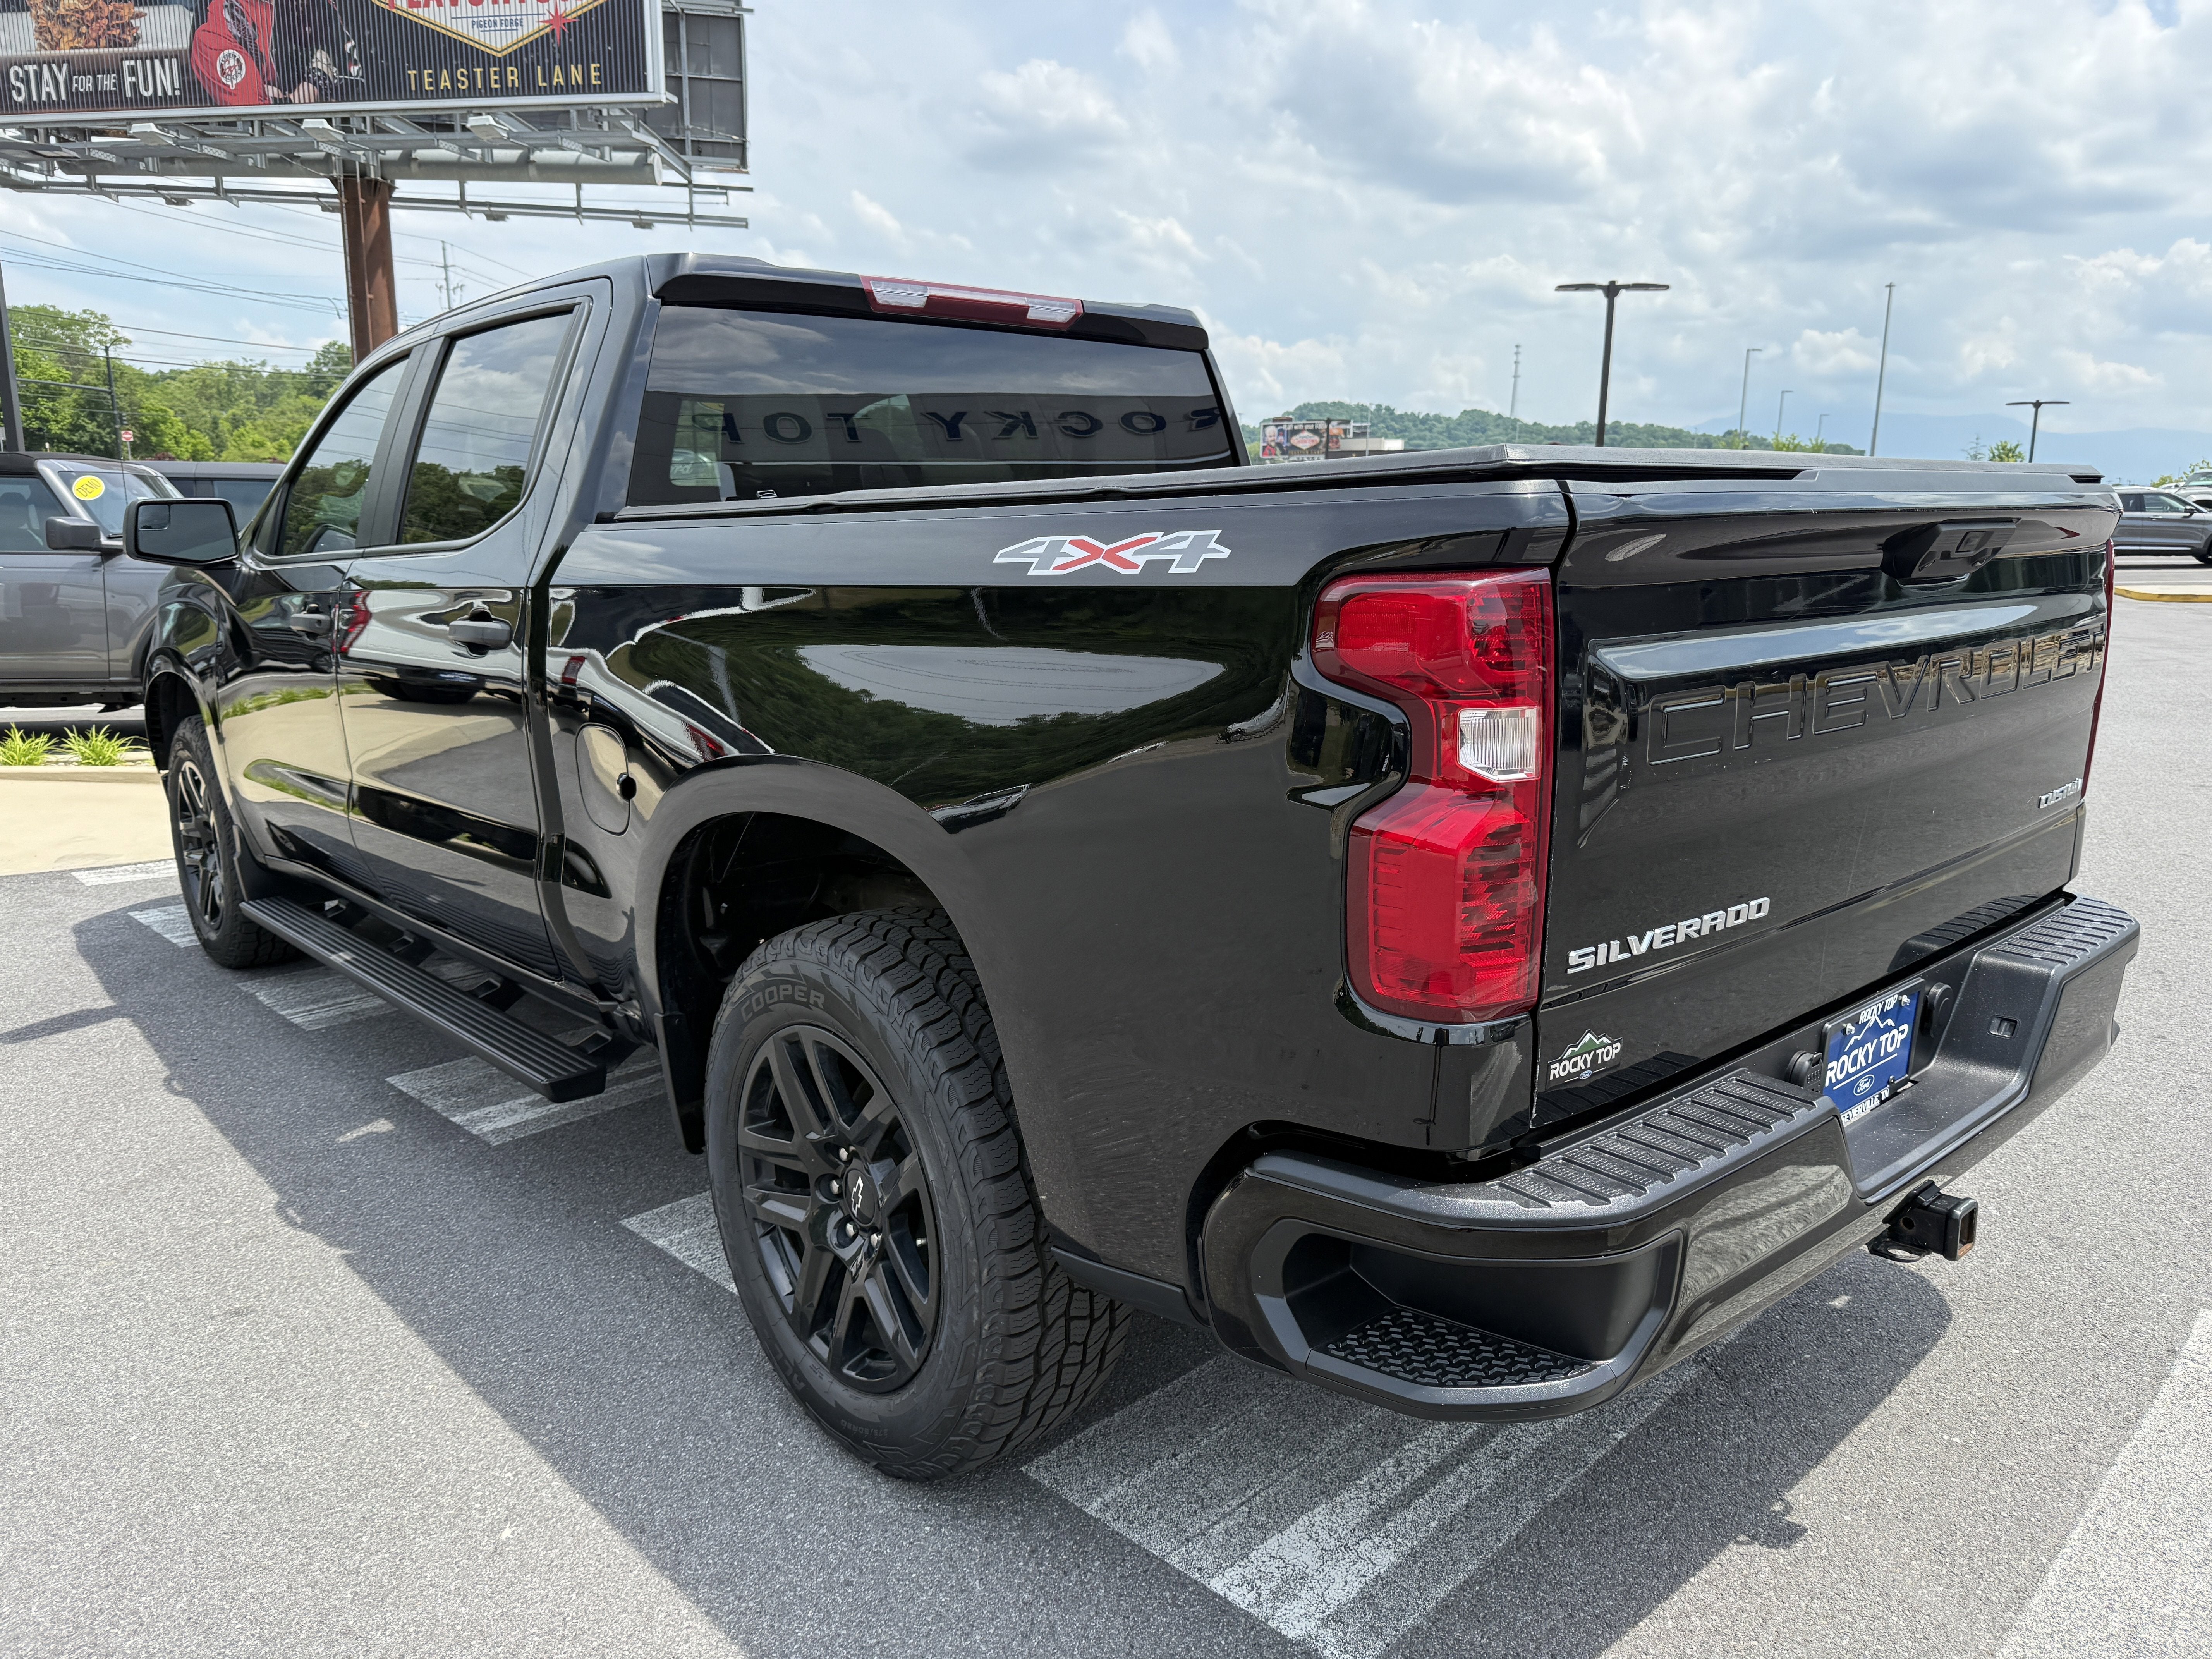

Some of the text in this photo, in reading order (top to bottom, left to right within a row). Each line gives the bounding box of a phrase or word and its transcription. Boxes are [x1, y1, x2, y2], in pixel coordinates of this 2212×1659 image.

[471, 18, 524, 29] PIGEON FORGE
[9, 58, 180, 103] STAY FOR THE FUN!
[407, 63, 601, 91] TEASTER LANE
[76, 479, 101, 497] DEMO
[1647, 621, 2104, 766] CHEVROLET
[1566, 897, 1771, 974] SILVERADO
[740, 984, 824, 1022] COOPER
[1858, 994, 1898, 1025] ROCKY TOP
[1549, 1042, 1621, 1080] ROCKY TOP
[1825, 1024, 1909, 1087] ROCKY TOP
[1856, 1077, 1872, 1093] Ford
[1881, 1088, 1890, 1101] TN
